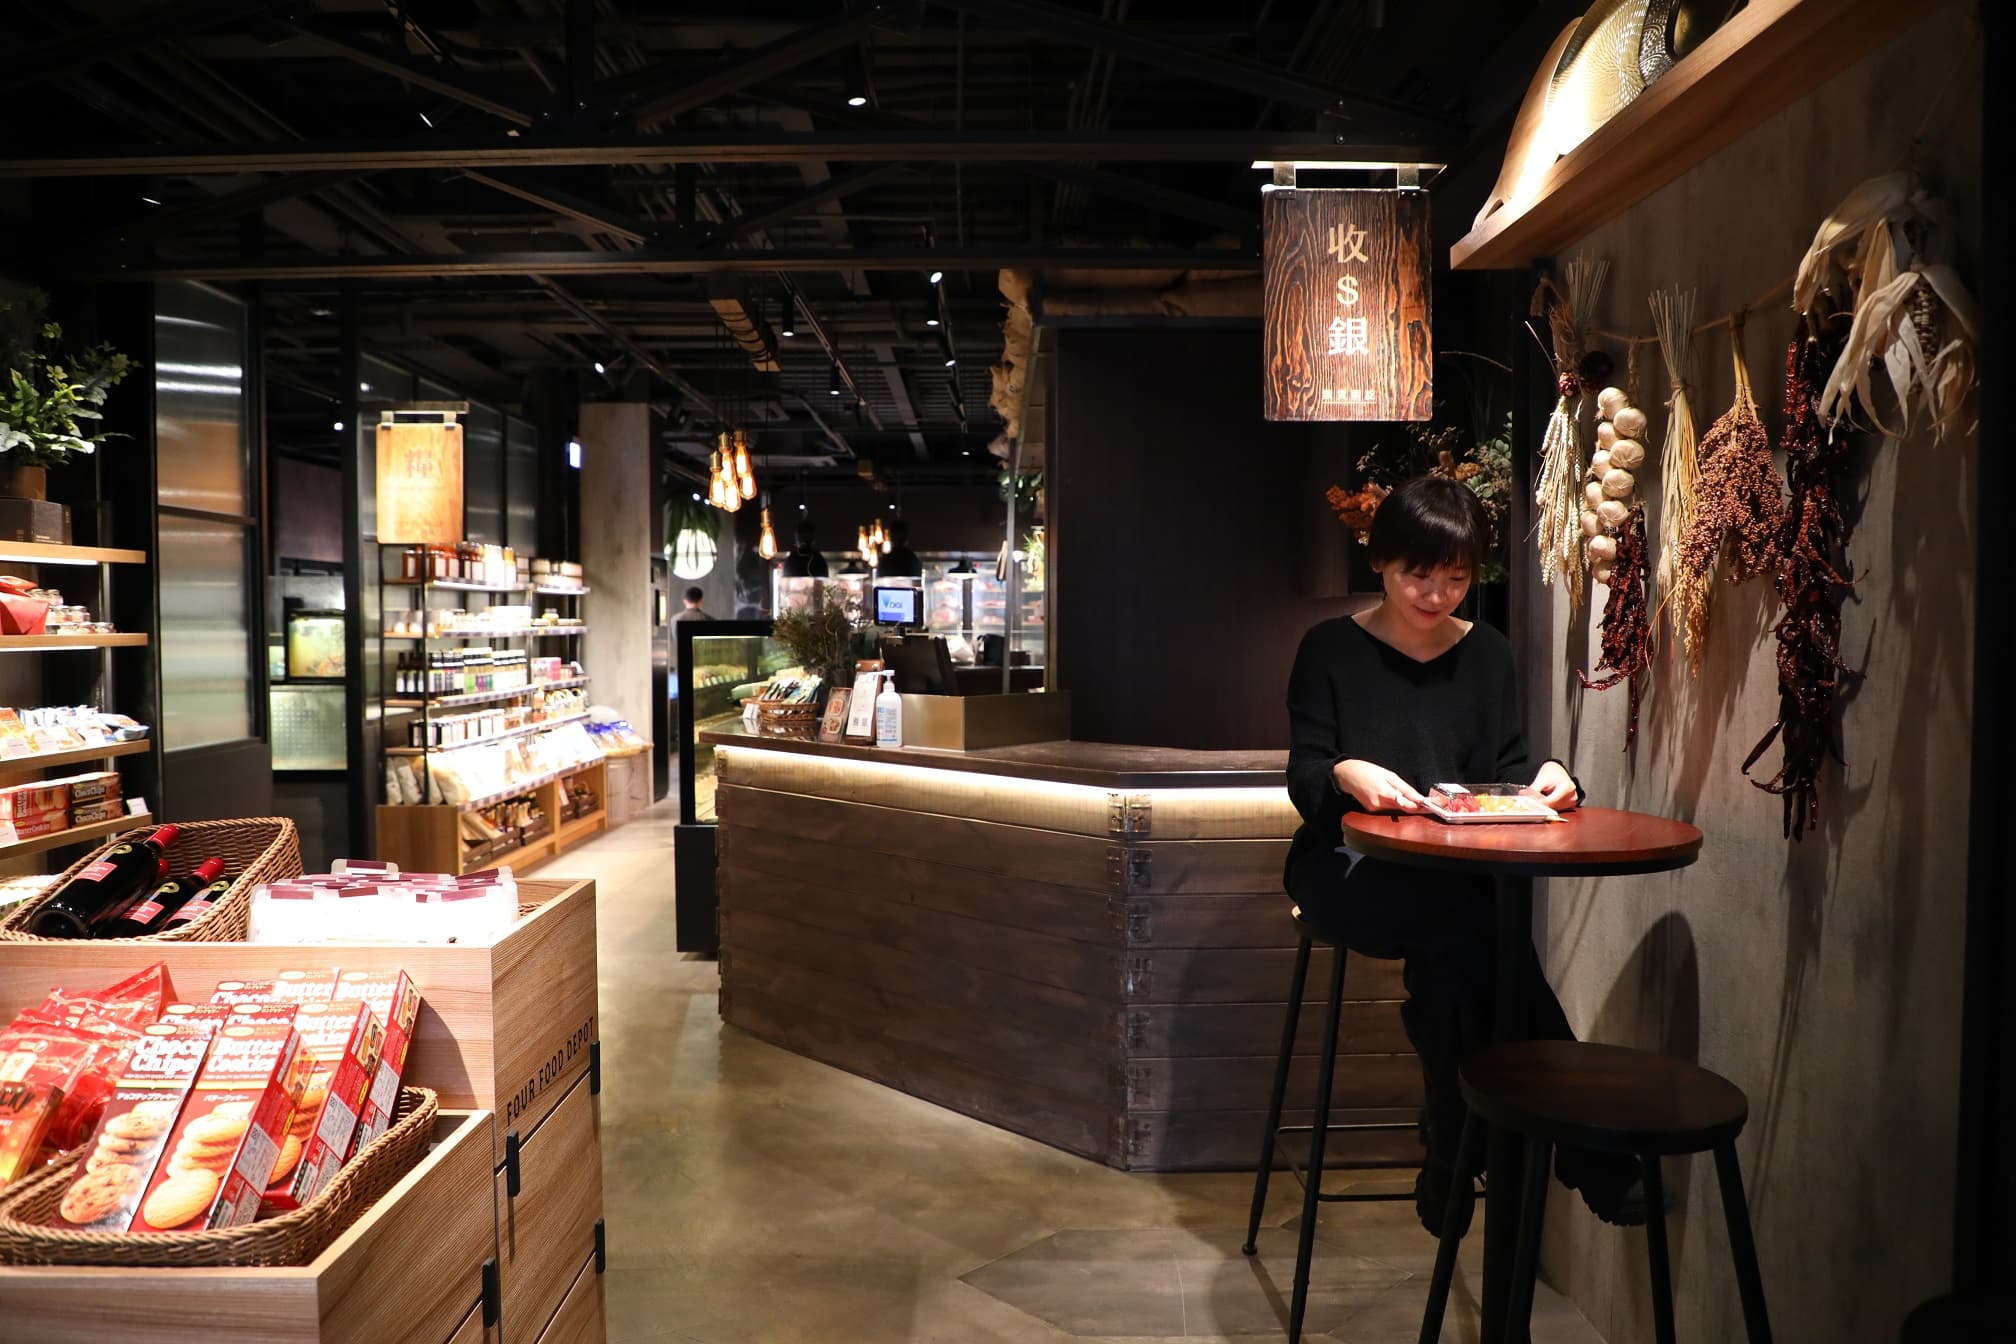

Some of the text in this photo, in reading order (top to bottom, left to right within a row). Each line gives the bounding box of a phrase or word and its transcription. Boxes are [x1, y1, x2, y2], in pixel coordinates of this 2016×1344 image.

[135, 1035, 210, 1056] Choco
[215, 1037, 286, 1055] Butter
[130, 1053, 199, 1076] Chips
[207, 1055, 277, 1072] Cookies
[506, 1016, 594, 1127] FOUR FOOD DEPOT
